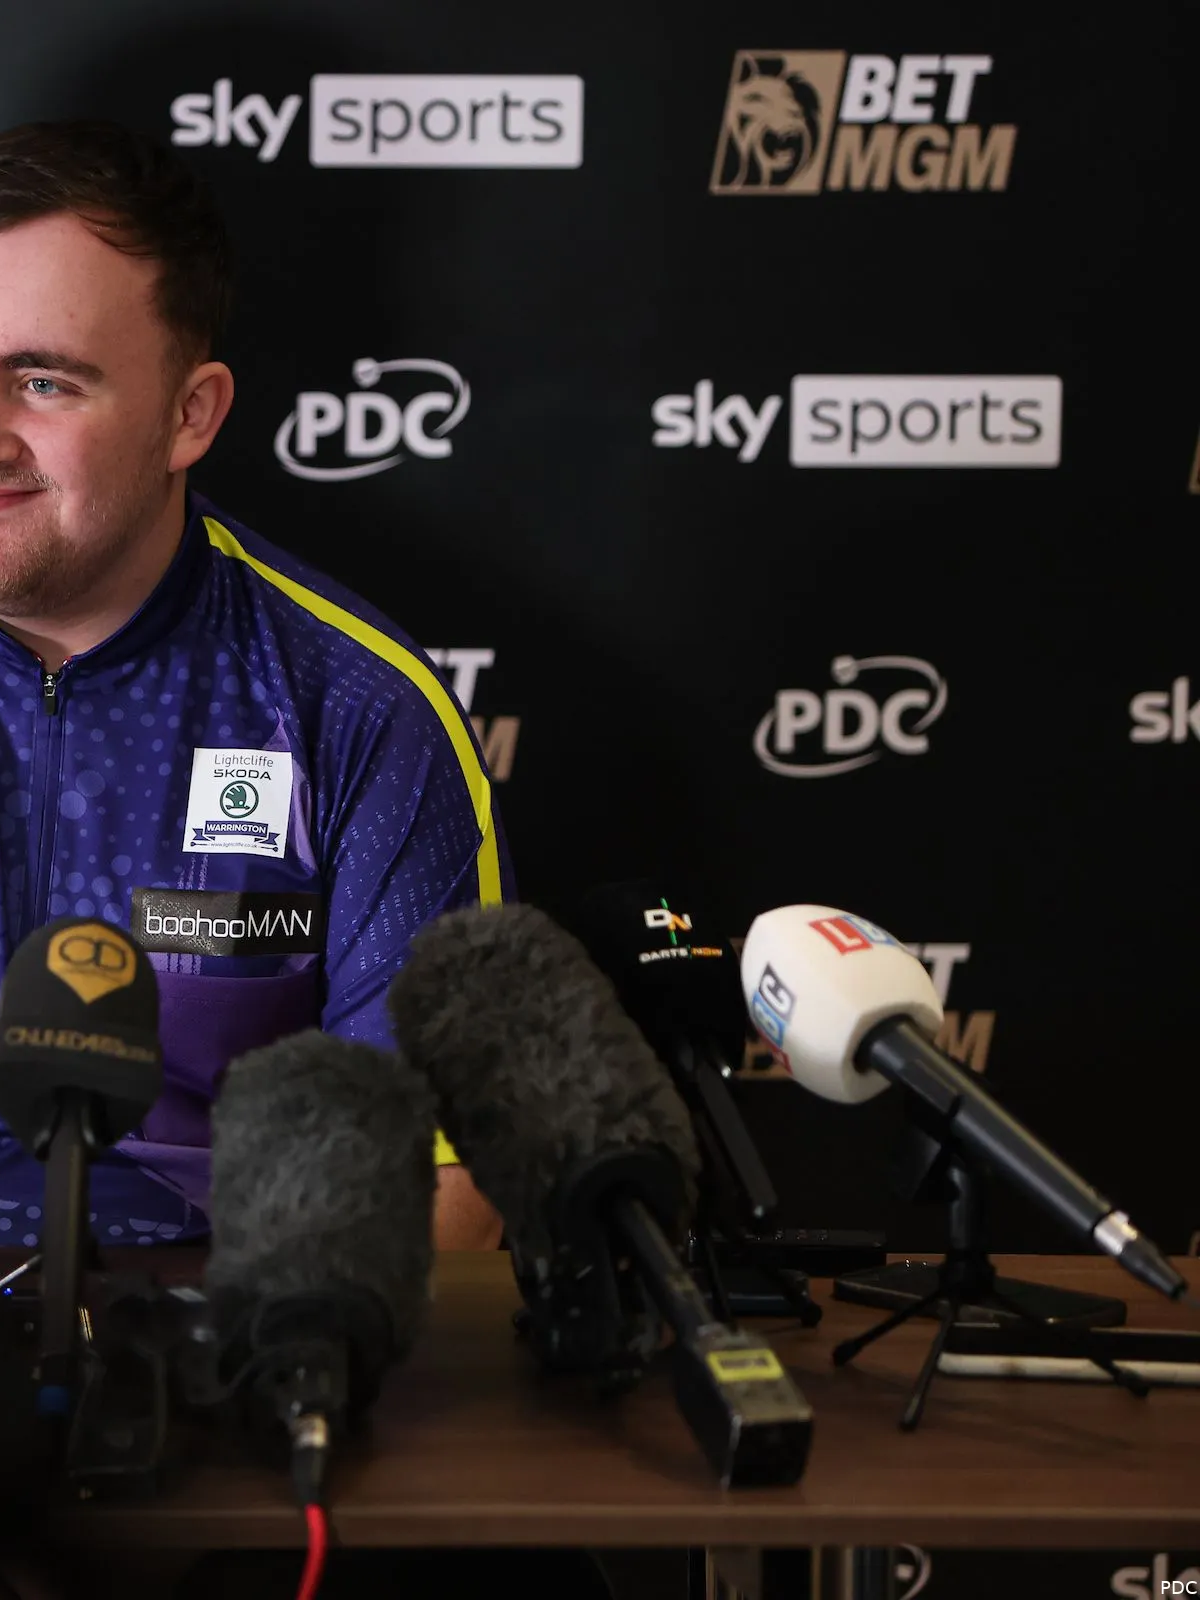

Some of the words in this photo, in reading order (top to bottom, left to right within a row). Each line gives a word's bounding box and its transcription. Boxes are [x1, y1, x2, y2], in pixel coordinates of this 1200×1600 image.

[170, 78, 302, 162] sky
[328, 92, 565, 155] sports
[839, 54, 992, 123] BET
[827, 124, 1017, 192] MGM
[296, 391, 453, 459] PDC
[652, 379, 782, 463] sky
[809, 391, 1044, 454] sports
[775, 690, 930, 755] PDC
[1129, 676, 1200, 744] sk
[214, 754, 274, 768] Lightcliffe
[206, 823, 267, 834] WARRINGTON
[146, 907, 313, 938] boohooMAN
